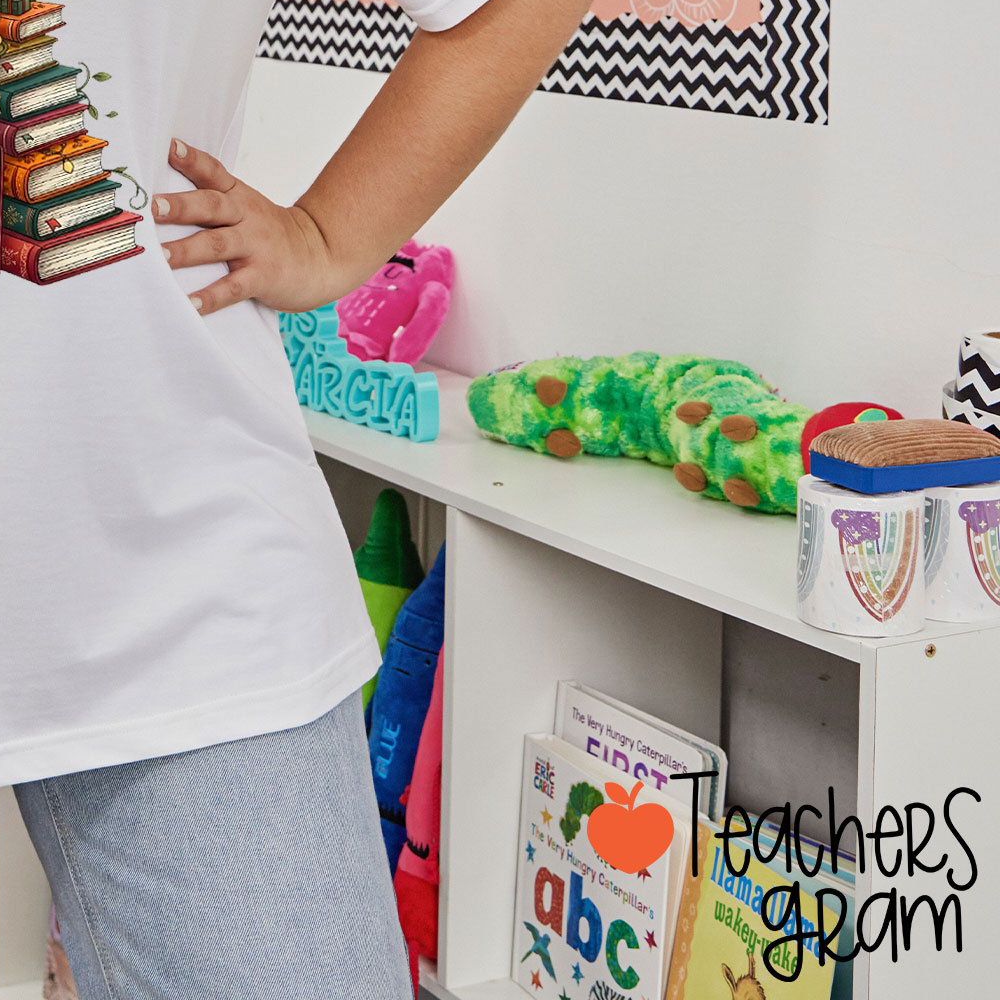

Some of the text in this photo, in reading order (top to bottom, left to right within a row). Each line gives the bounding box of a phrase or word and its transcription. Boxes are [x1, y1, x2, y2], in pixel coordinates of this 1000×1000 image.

[286, 348, 419, 437] ARCIA
[375, 718, 402, 780] BLUE
[534, 760, 556, 786] ERIC
[572, 706, 688, 775] The Very Hungry Caterpillar's
[533, 776, 555, 800] CARLE
[531, 822, 655, 920] The Very Hungry Caterpillar's
[533, 866, 640, 990] abc
